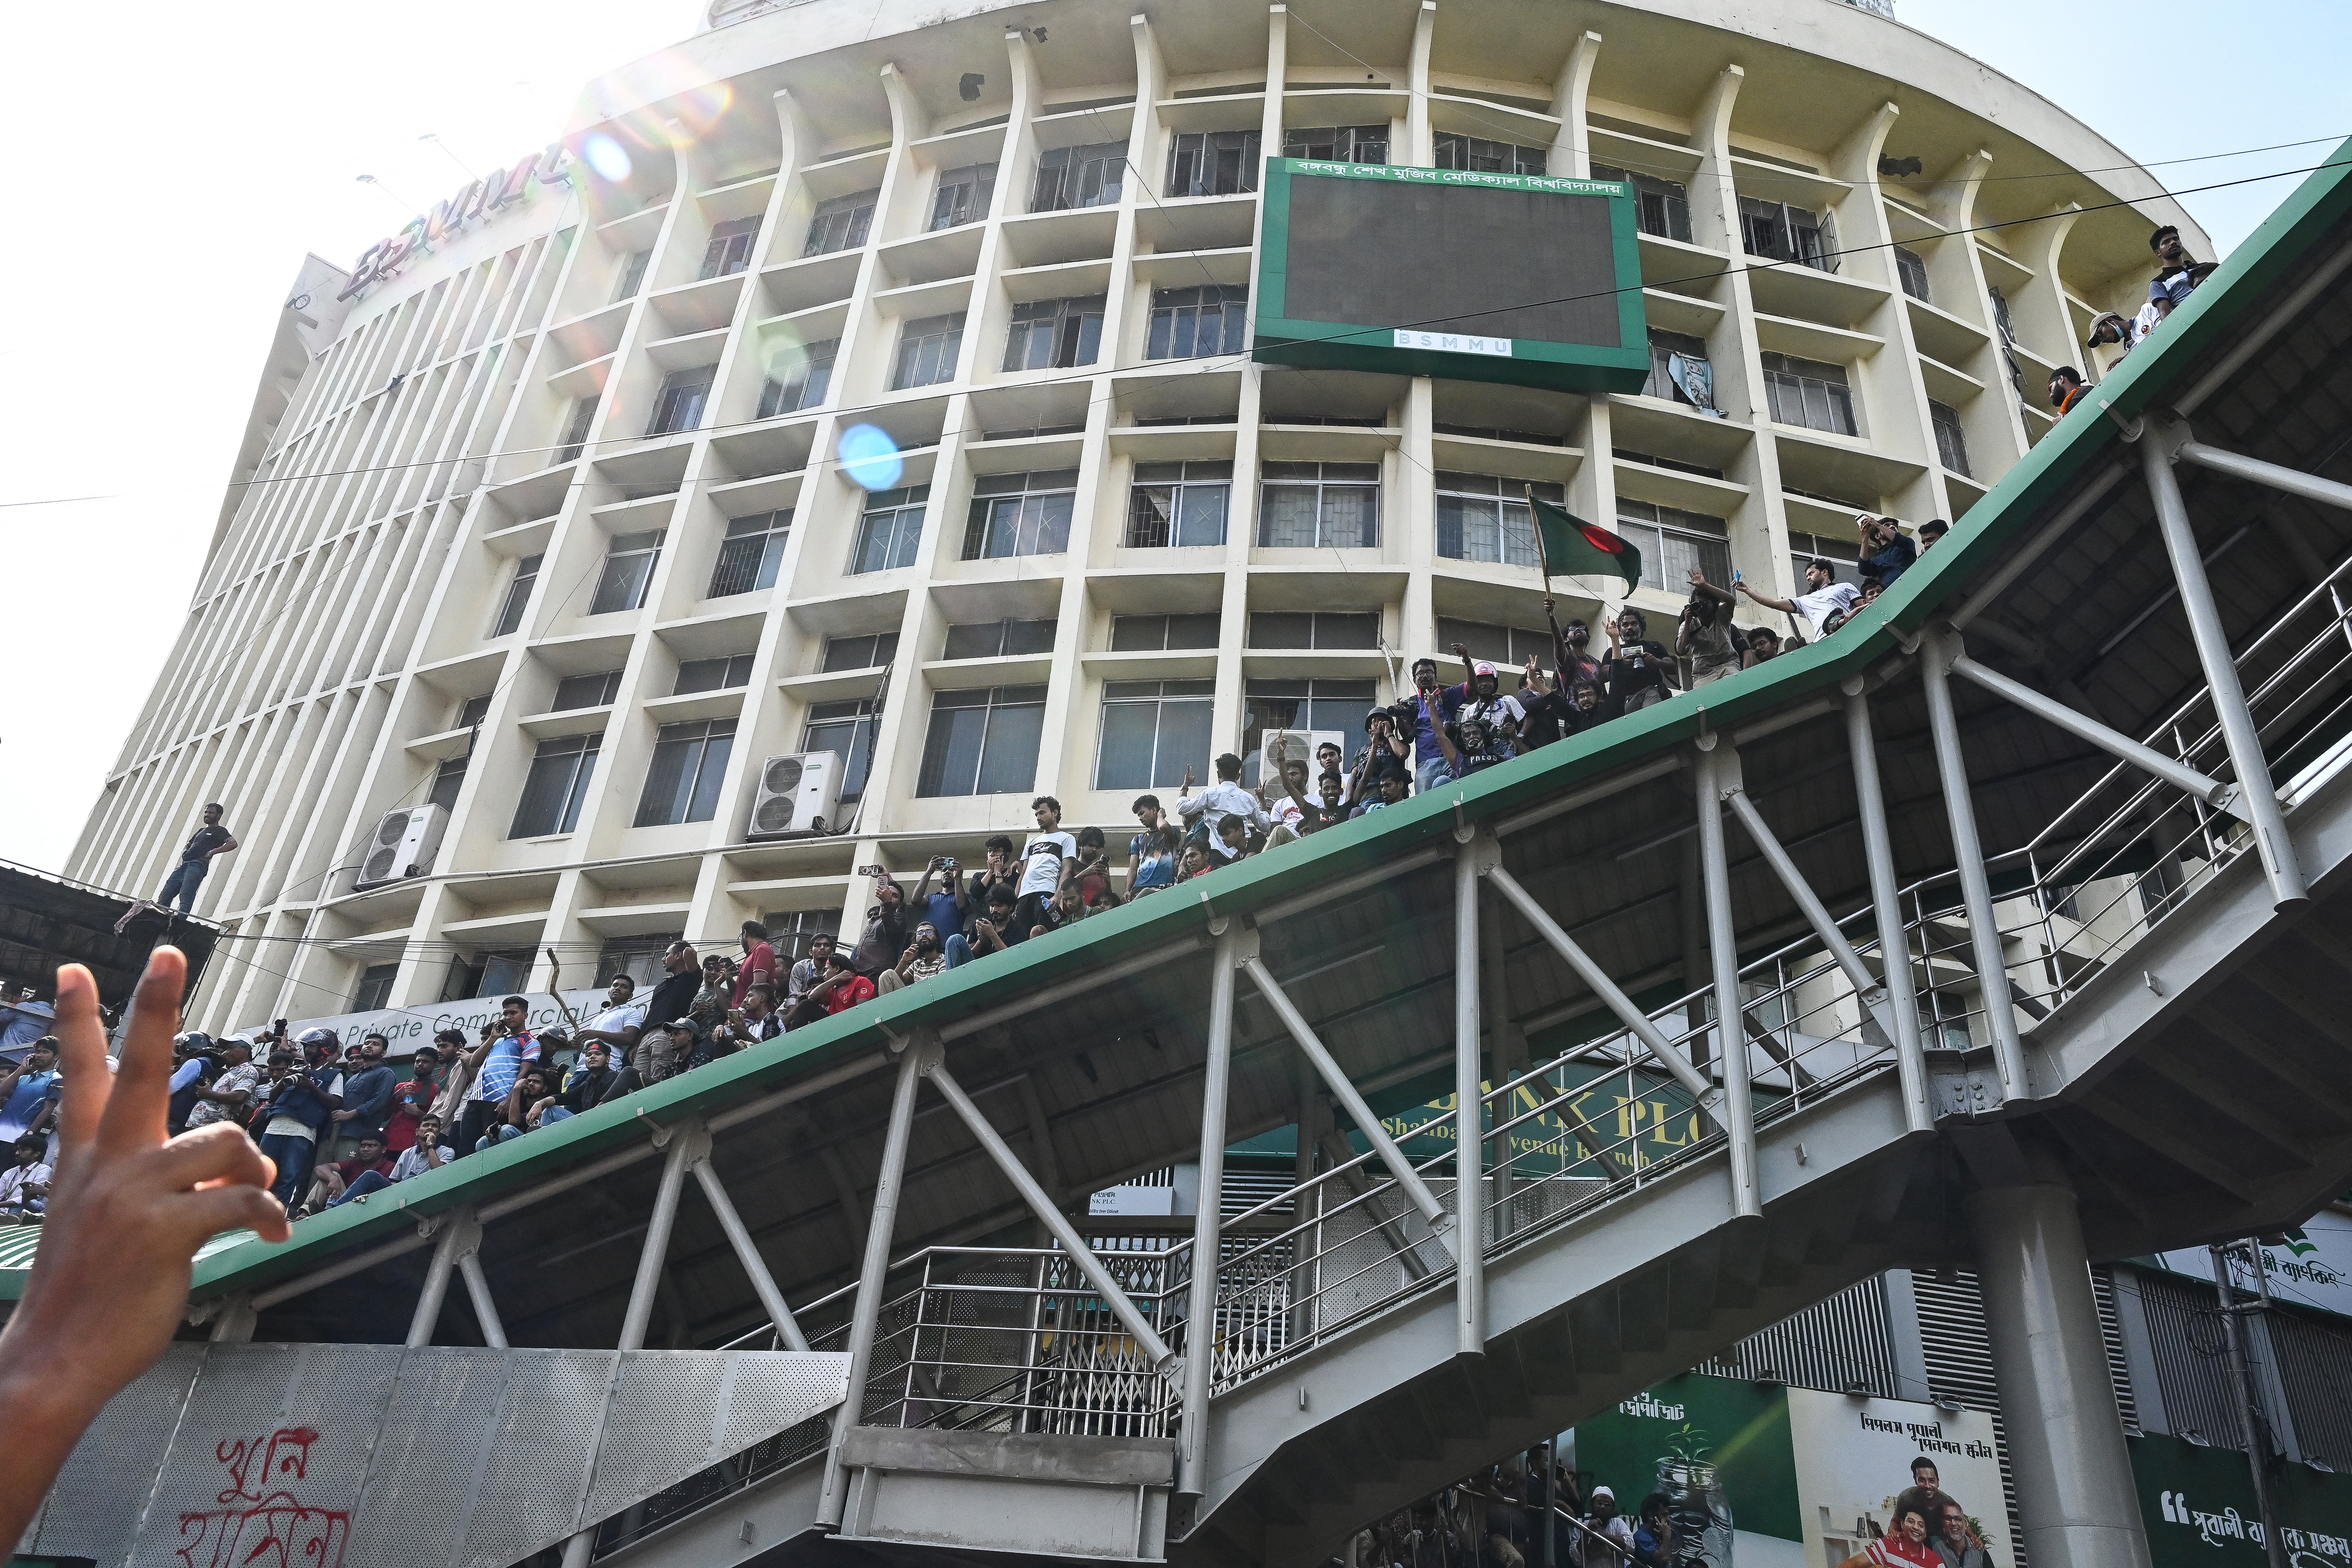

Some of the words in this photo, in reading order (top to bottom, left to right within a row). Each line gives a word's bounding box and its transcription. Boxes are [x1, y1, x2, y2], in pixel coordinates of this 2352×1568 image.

[1296, 161, 1348, 176] বঙ্গবন্ধু
[1353, 166, 1388, 176] শেখ
[1391, 168, 1438, 180] মুজিব
[1443, 172, 1522, 186] মেডিক্যাল
[1525, 176, 1621, 193] বিশ্ববিদ্যালয়
[433, 1002, 589, 1034] Commrcial
[1860, 1412, 1903, 1435] পিপলস
[1906, 1421, 1943, 1442] পূবালী
[1919, 1437, 1961, 1455] পেনশন
[1964, 1440, 1993, 1459] স্কীম
[216, 1426, 320, 1504] খুনি
